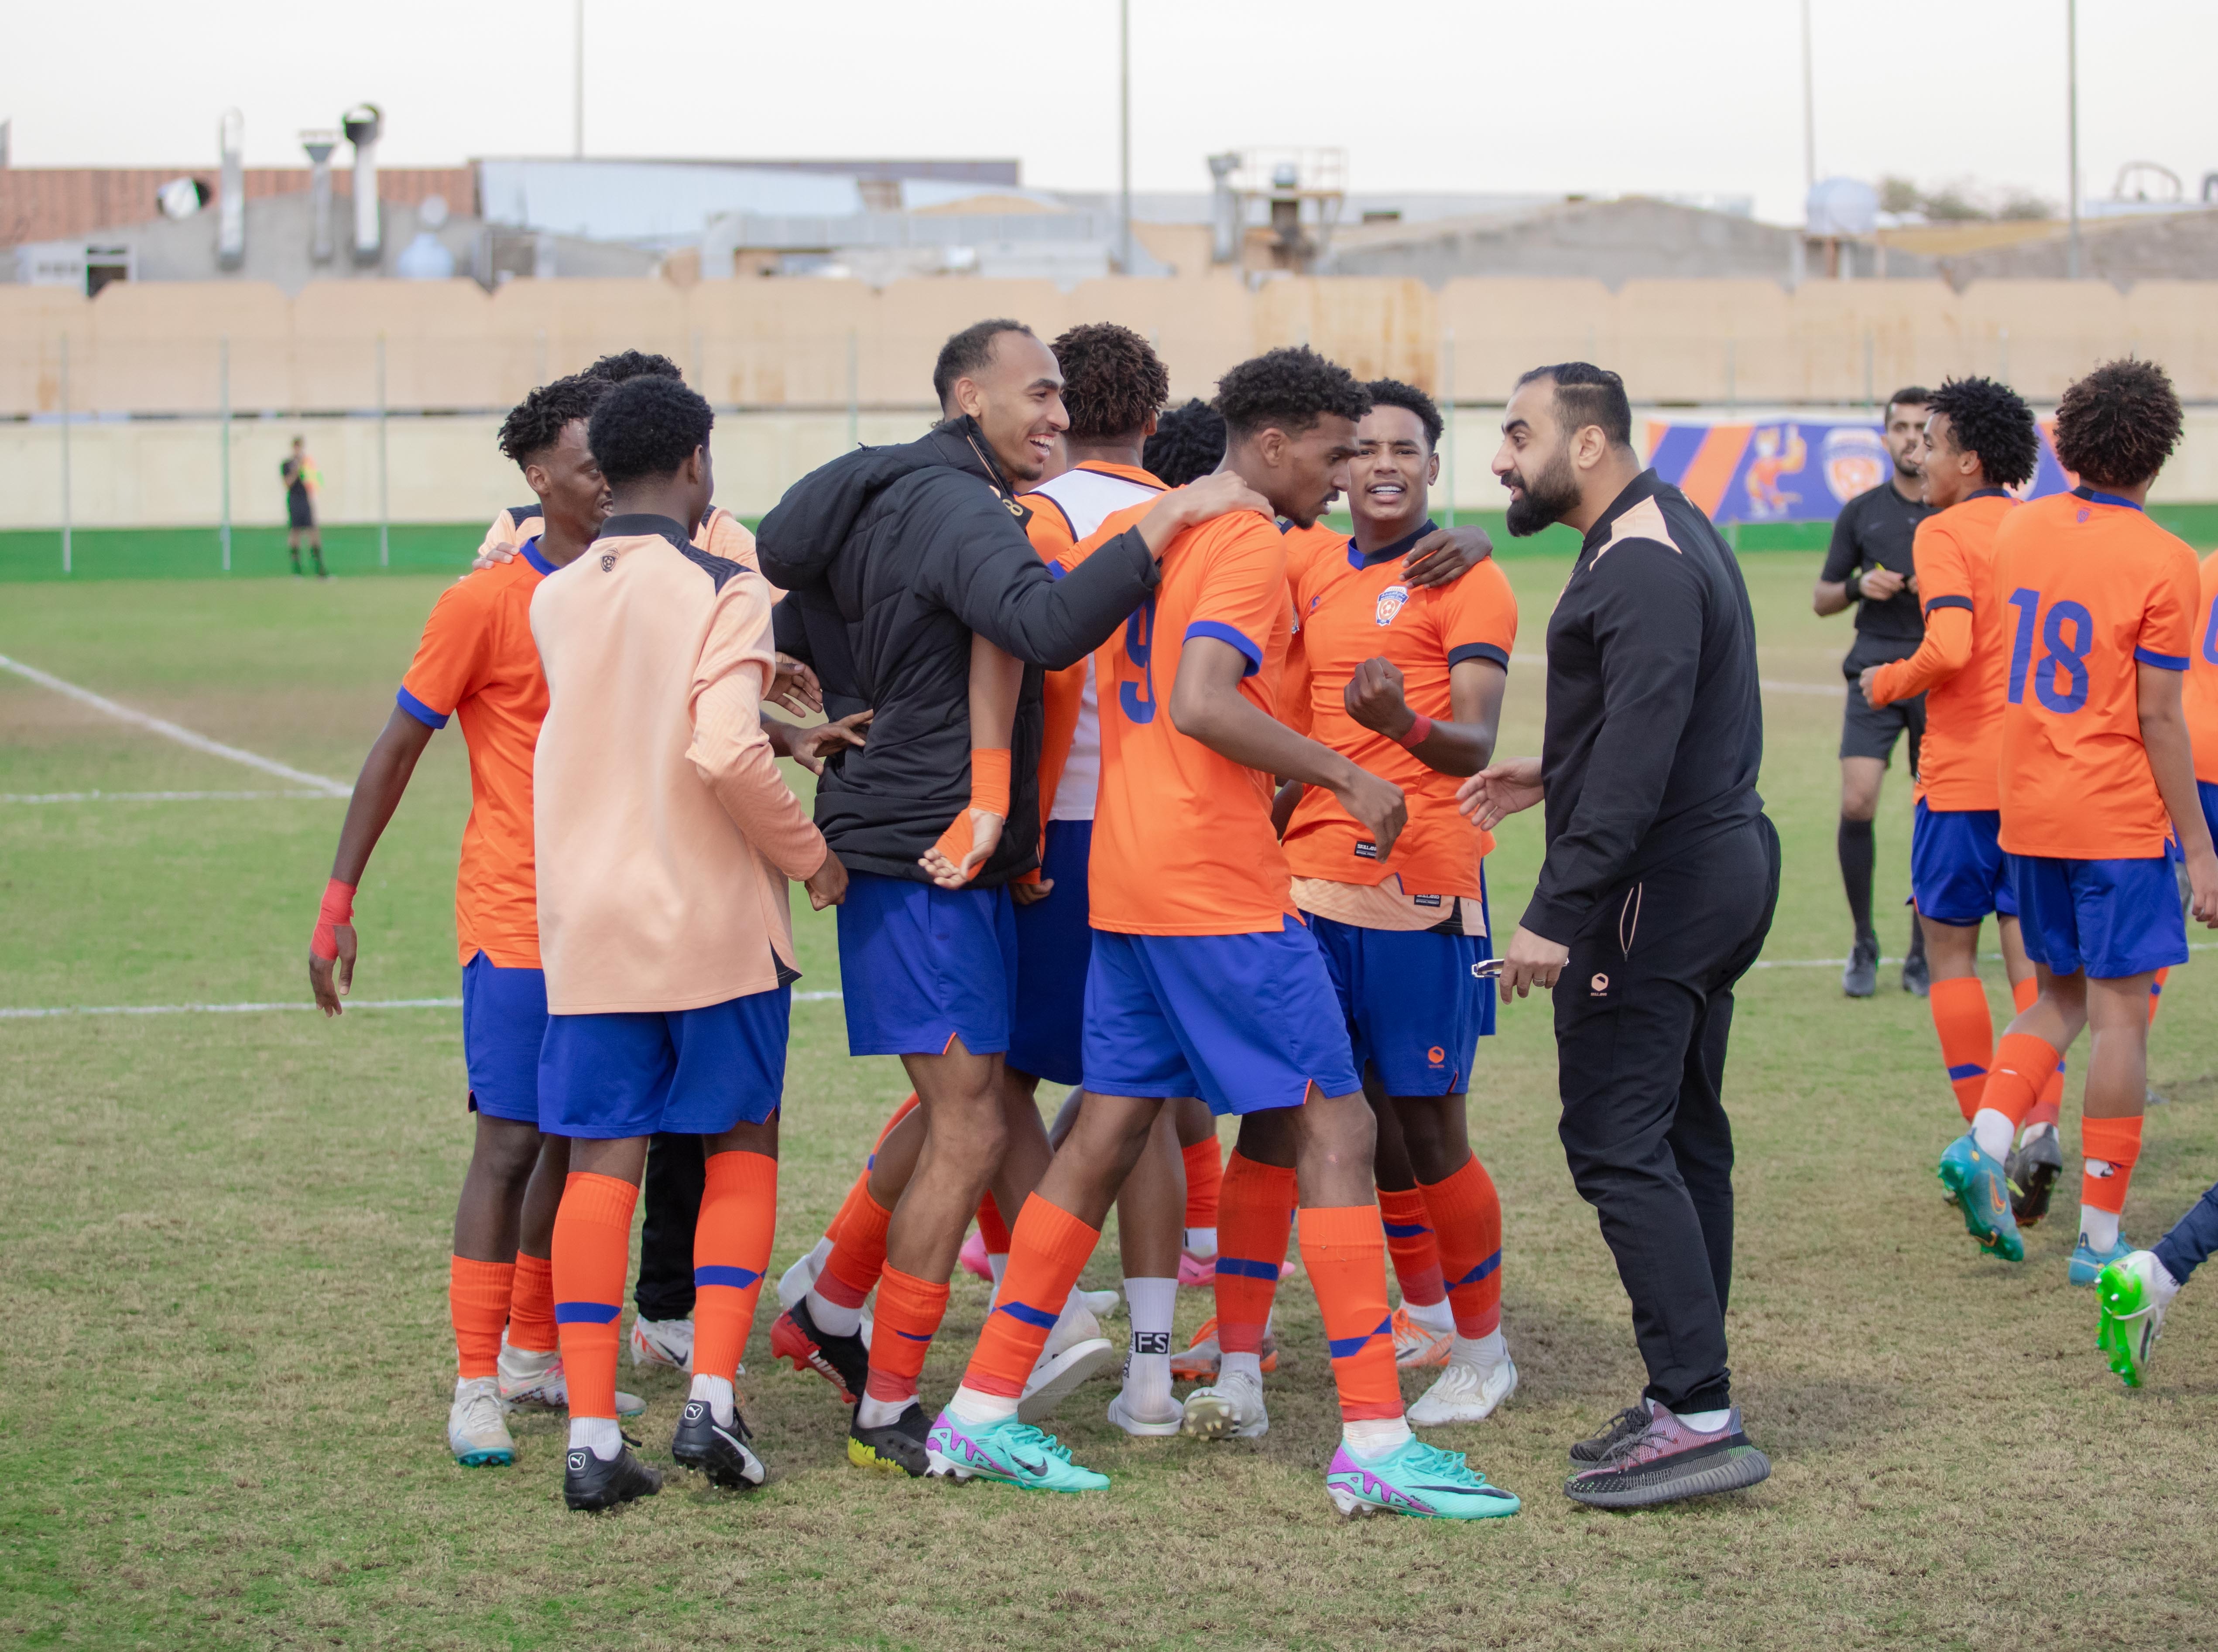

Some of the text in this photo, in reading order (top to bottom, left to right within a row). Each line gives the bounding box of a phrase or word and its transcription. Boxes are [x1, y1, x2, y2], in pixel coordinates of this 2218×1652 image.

[1120, 592, 1157, 725] 9
[2008, 587, 2093, 715] 18
[1138, 1333, 1167, 1353] FS
